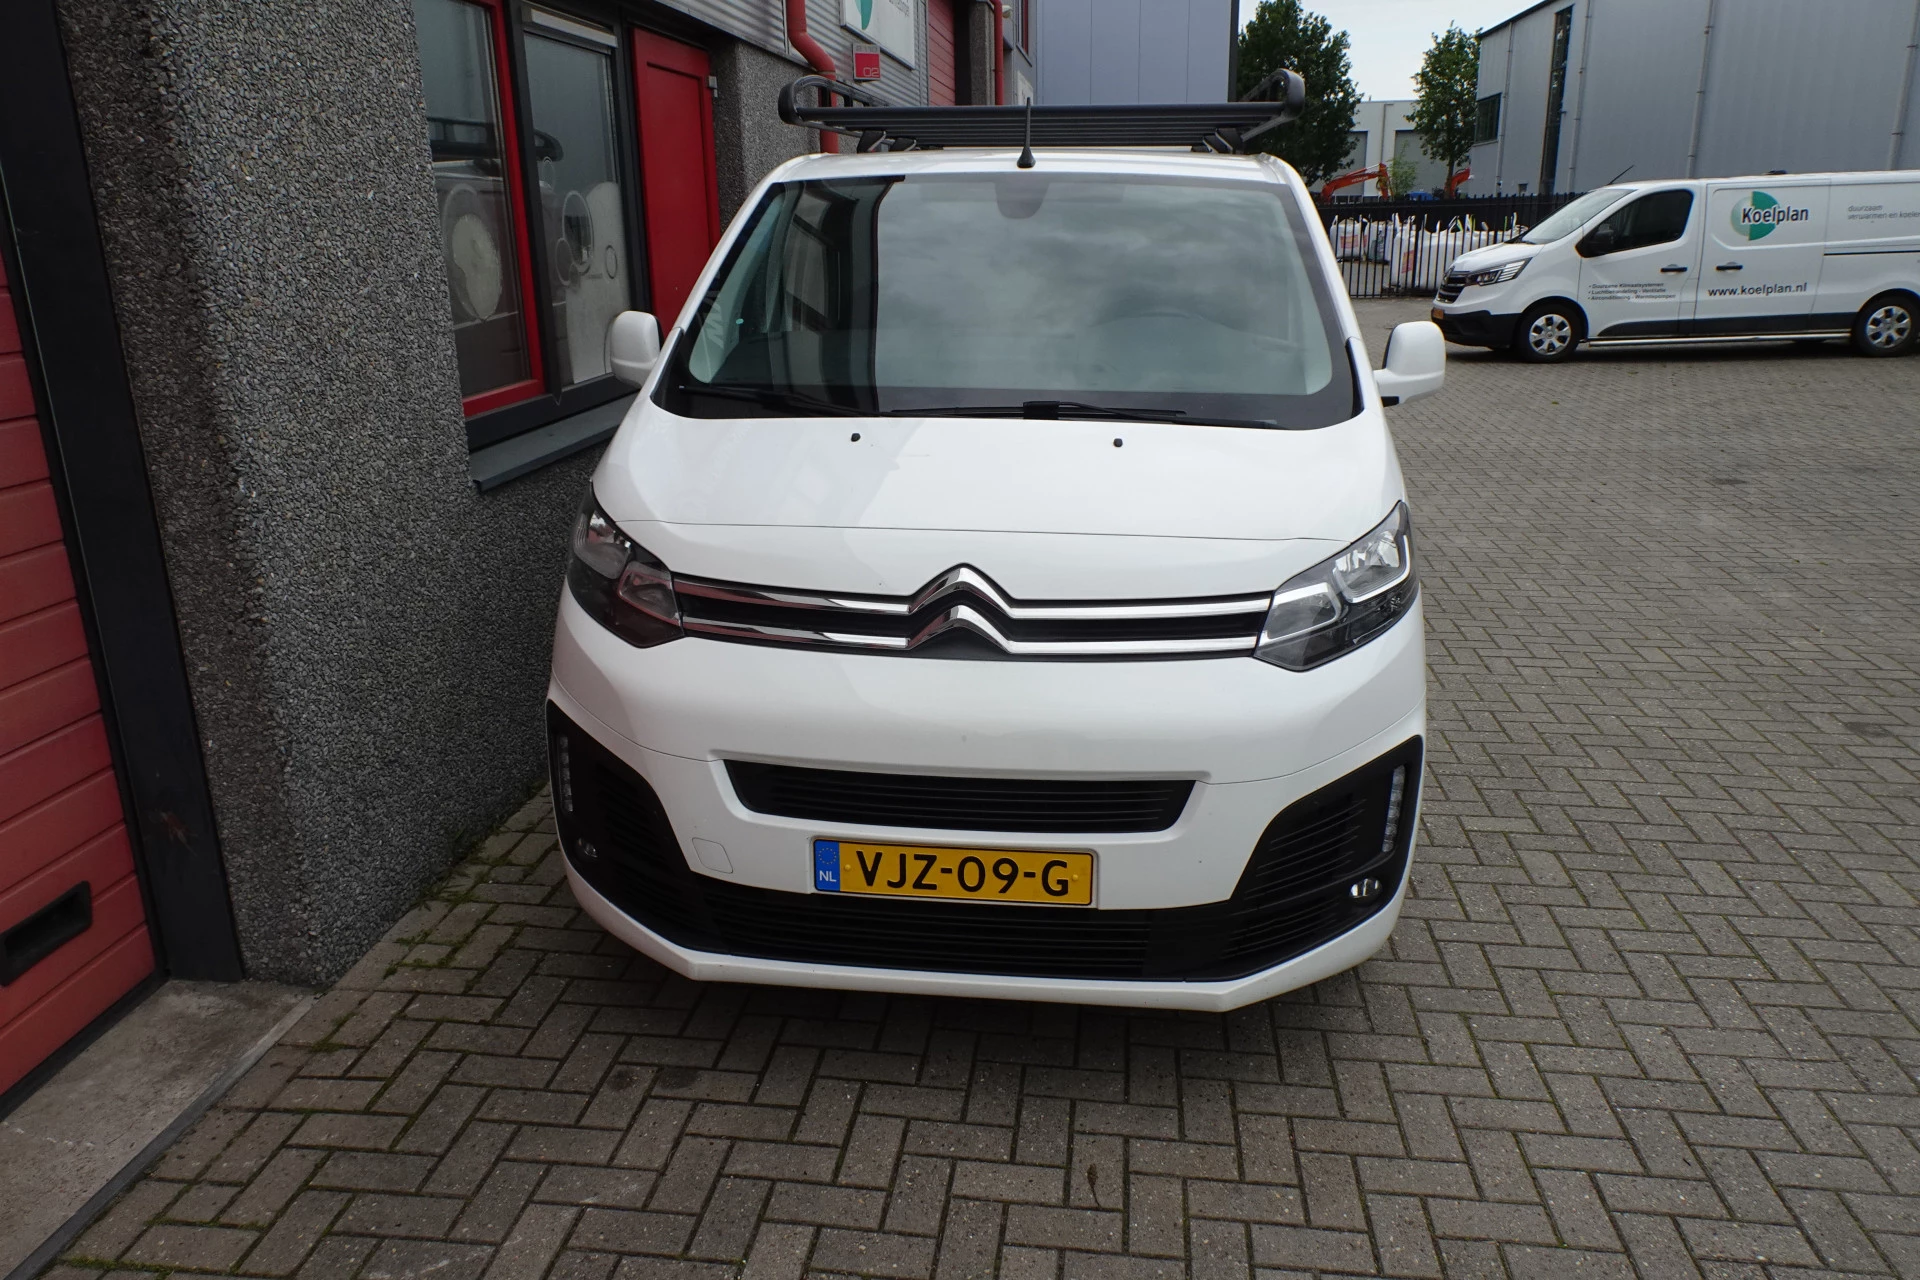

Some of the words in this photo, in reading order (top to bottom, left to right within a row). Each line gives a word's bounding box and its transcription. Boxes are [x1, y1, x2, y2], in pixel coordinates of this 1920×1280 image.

[863, 67, 879, 77] 02
[1741, 206, 1809, 225] Koelplan
[1708, 283, 1807, 297] www.koelplan.nl
[819, 871, 837, 883] NL
[856, 850, 1069, 897] VJZ-09-G
